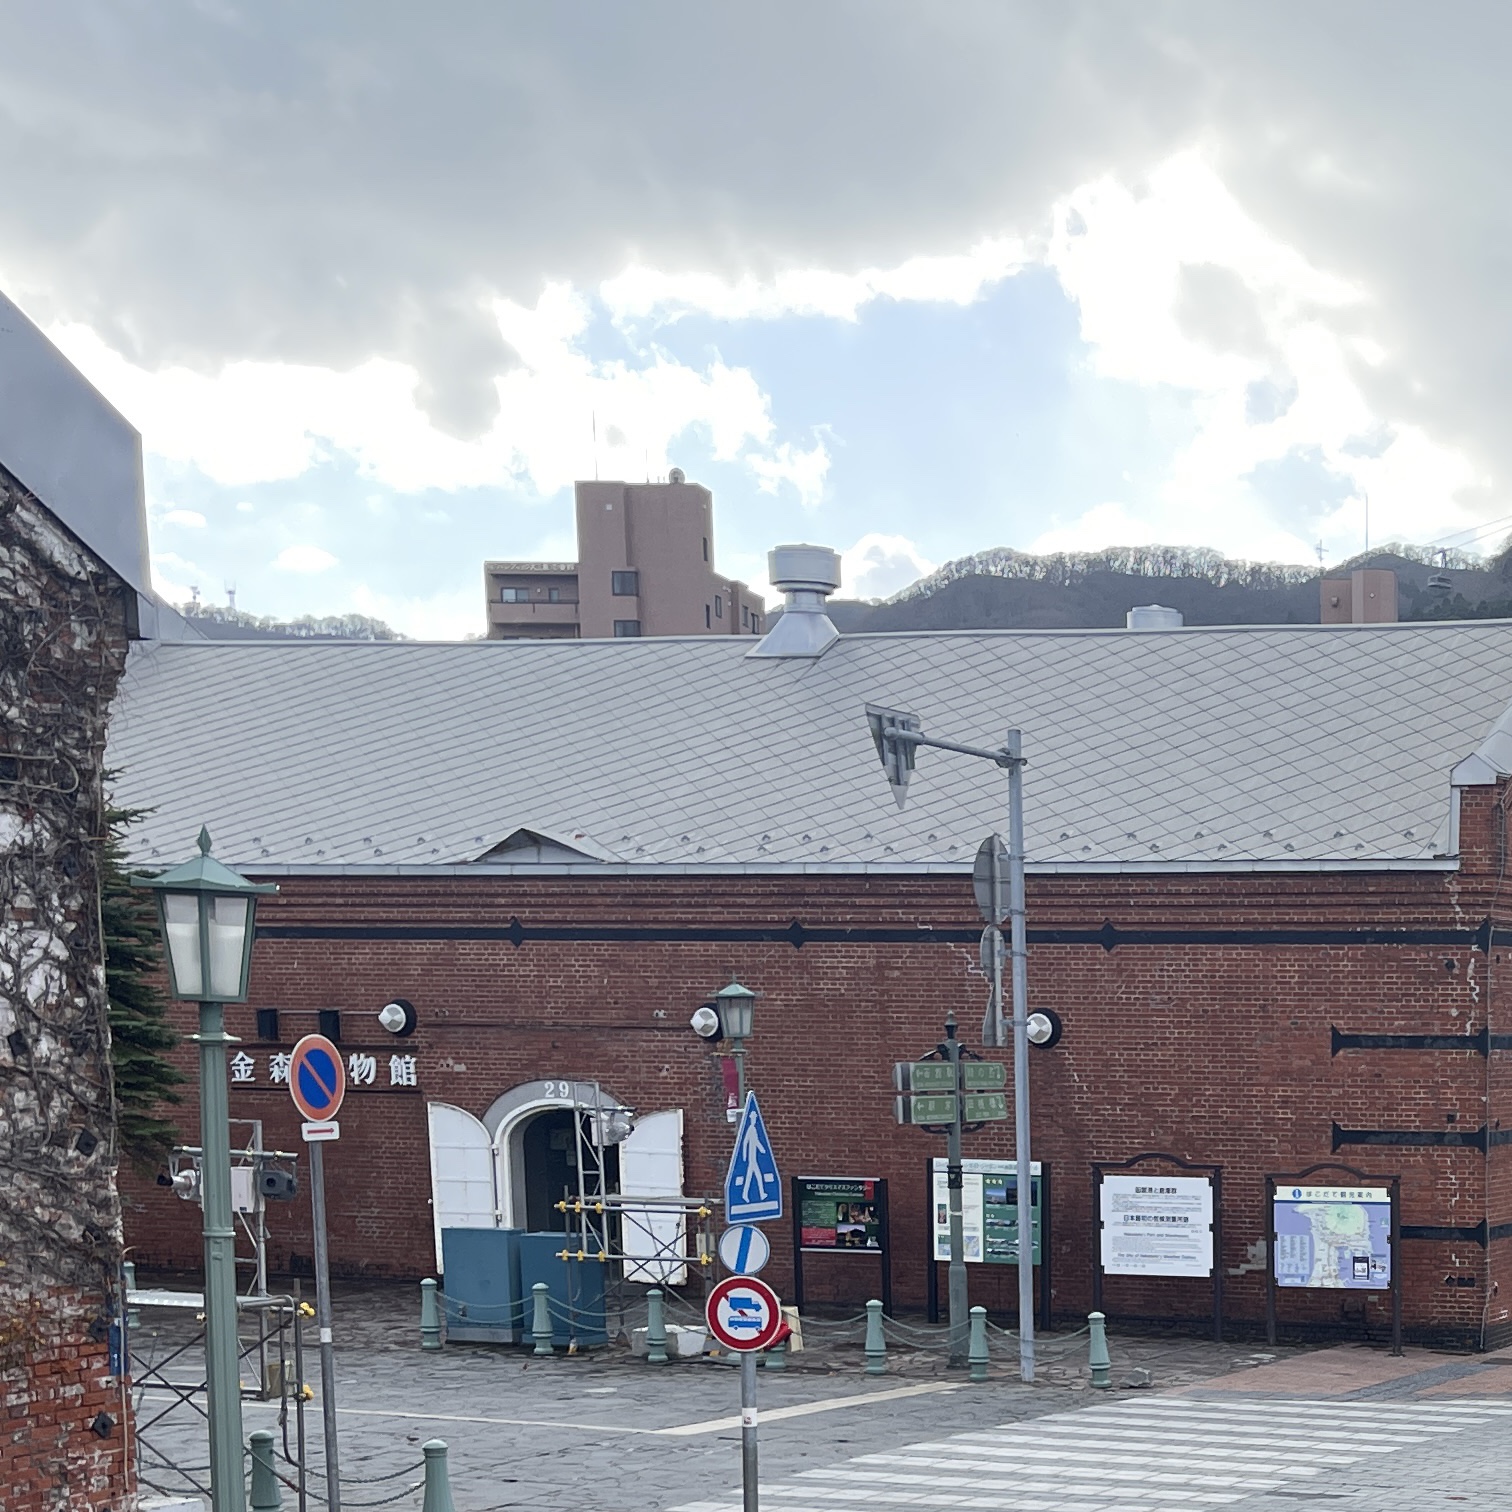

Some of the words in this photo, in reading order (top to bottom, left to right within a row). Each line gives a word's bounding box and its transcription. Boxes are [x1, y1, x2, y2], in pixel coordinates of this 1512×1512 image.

[229, 1050, 418, 1087] 金森物館
[544, 1081, 569, 1098] 29
